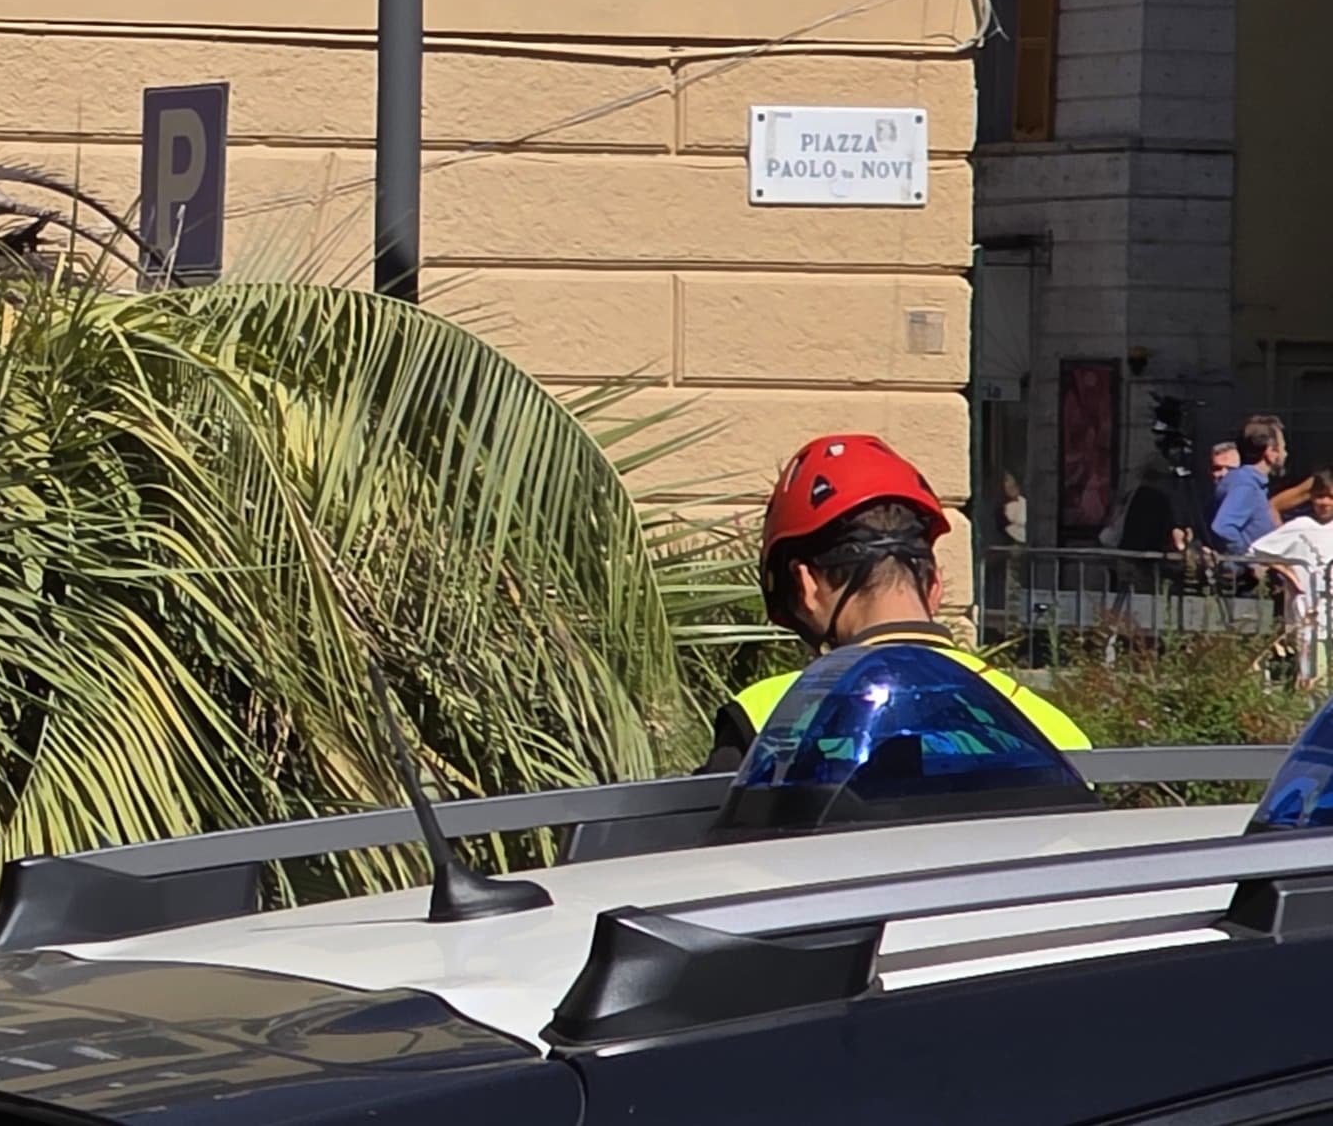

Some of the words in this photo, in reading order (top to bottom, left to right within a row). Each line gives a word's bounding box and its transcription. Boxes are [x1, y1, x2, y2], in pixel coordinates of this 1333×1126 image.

[800, 133, 878, 153] PIAZZA
[157, 108, 207, 251] P
[766, 159, 837, 178] PAOLO
[861, 160, 912, 180] NOVI
